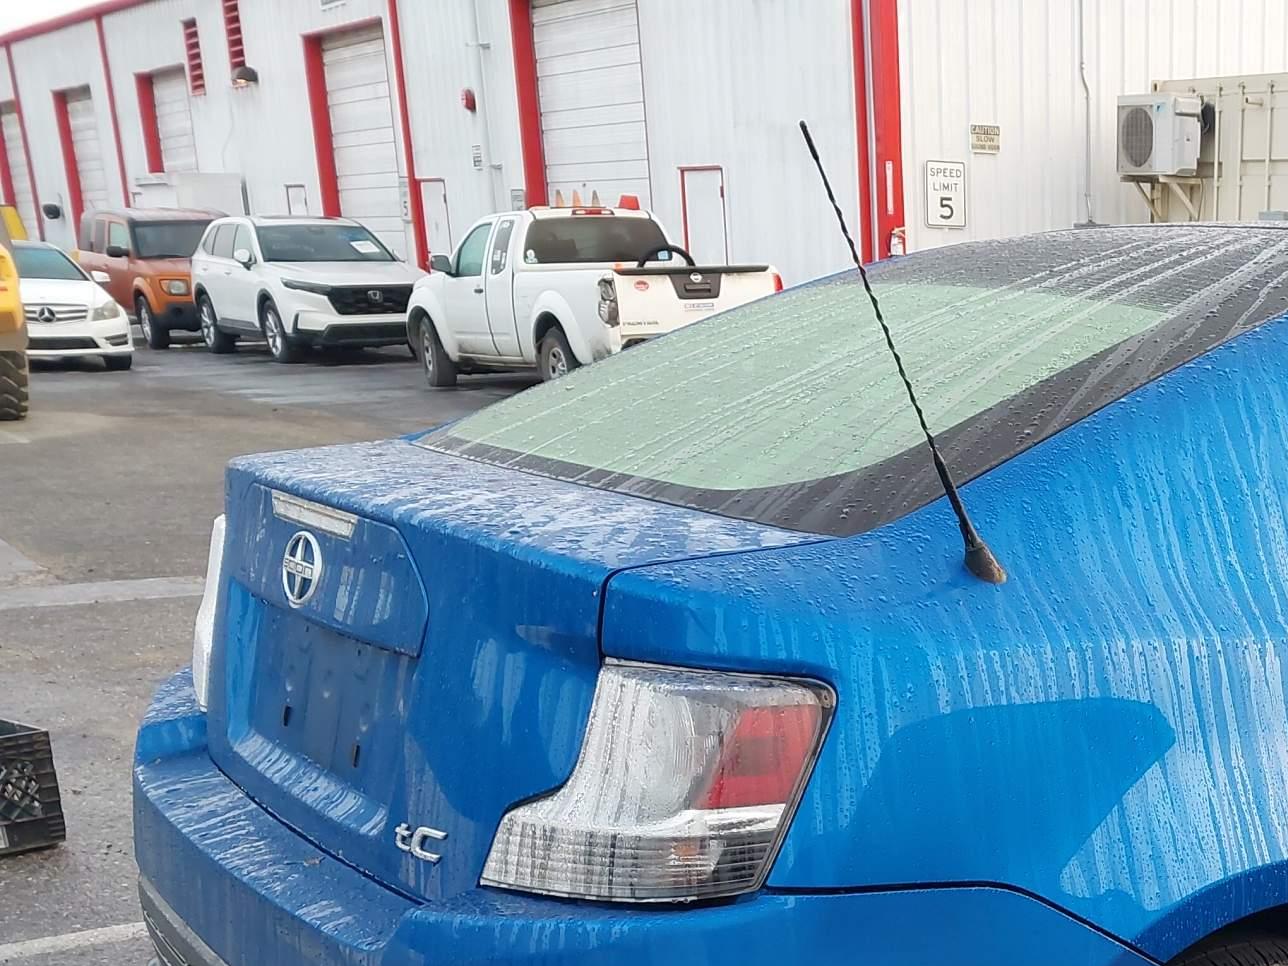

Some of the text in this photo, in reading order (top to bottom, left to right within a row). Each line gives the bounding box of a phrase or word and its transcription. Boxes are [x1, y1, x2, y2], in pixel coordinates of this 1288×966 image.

[976, 135, 995, 143] SLOW
[929, 167, 962, 178] SPEED
[933, 182, 959, 193] LIMIT
[939, 196, 954, 220] 5
[395, 823, 448, 863] tC
